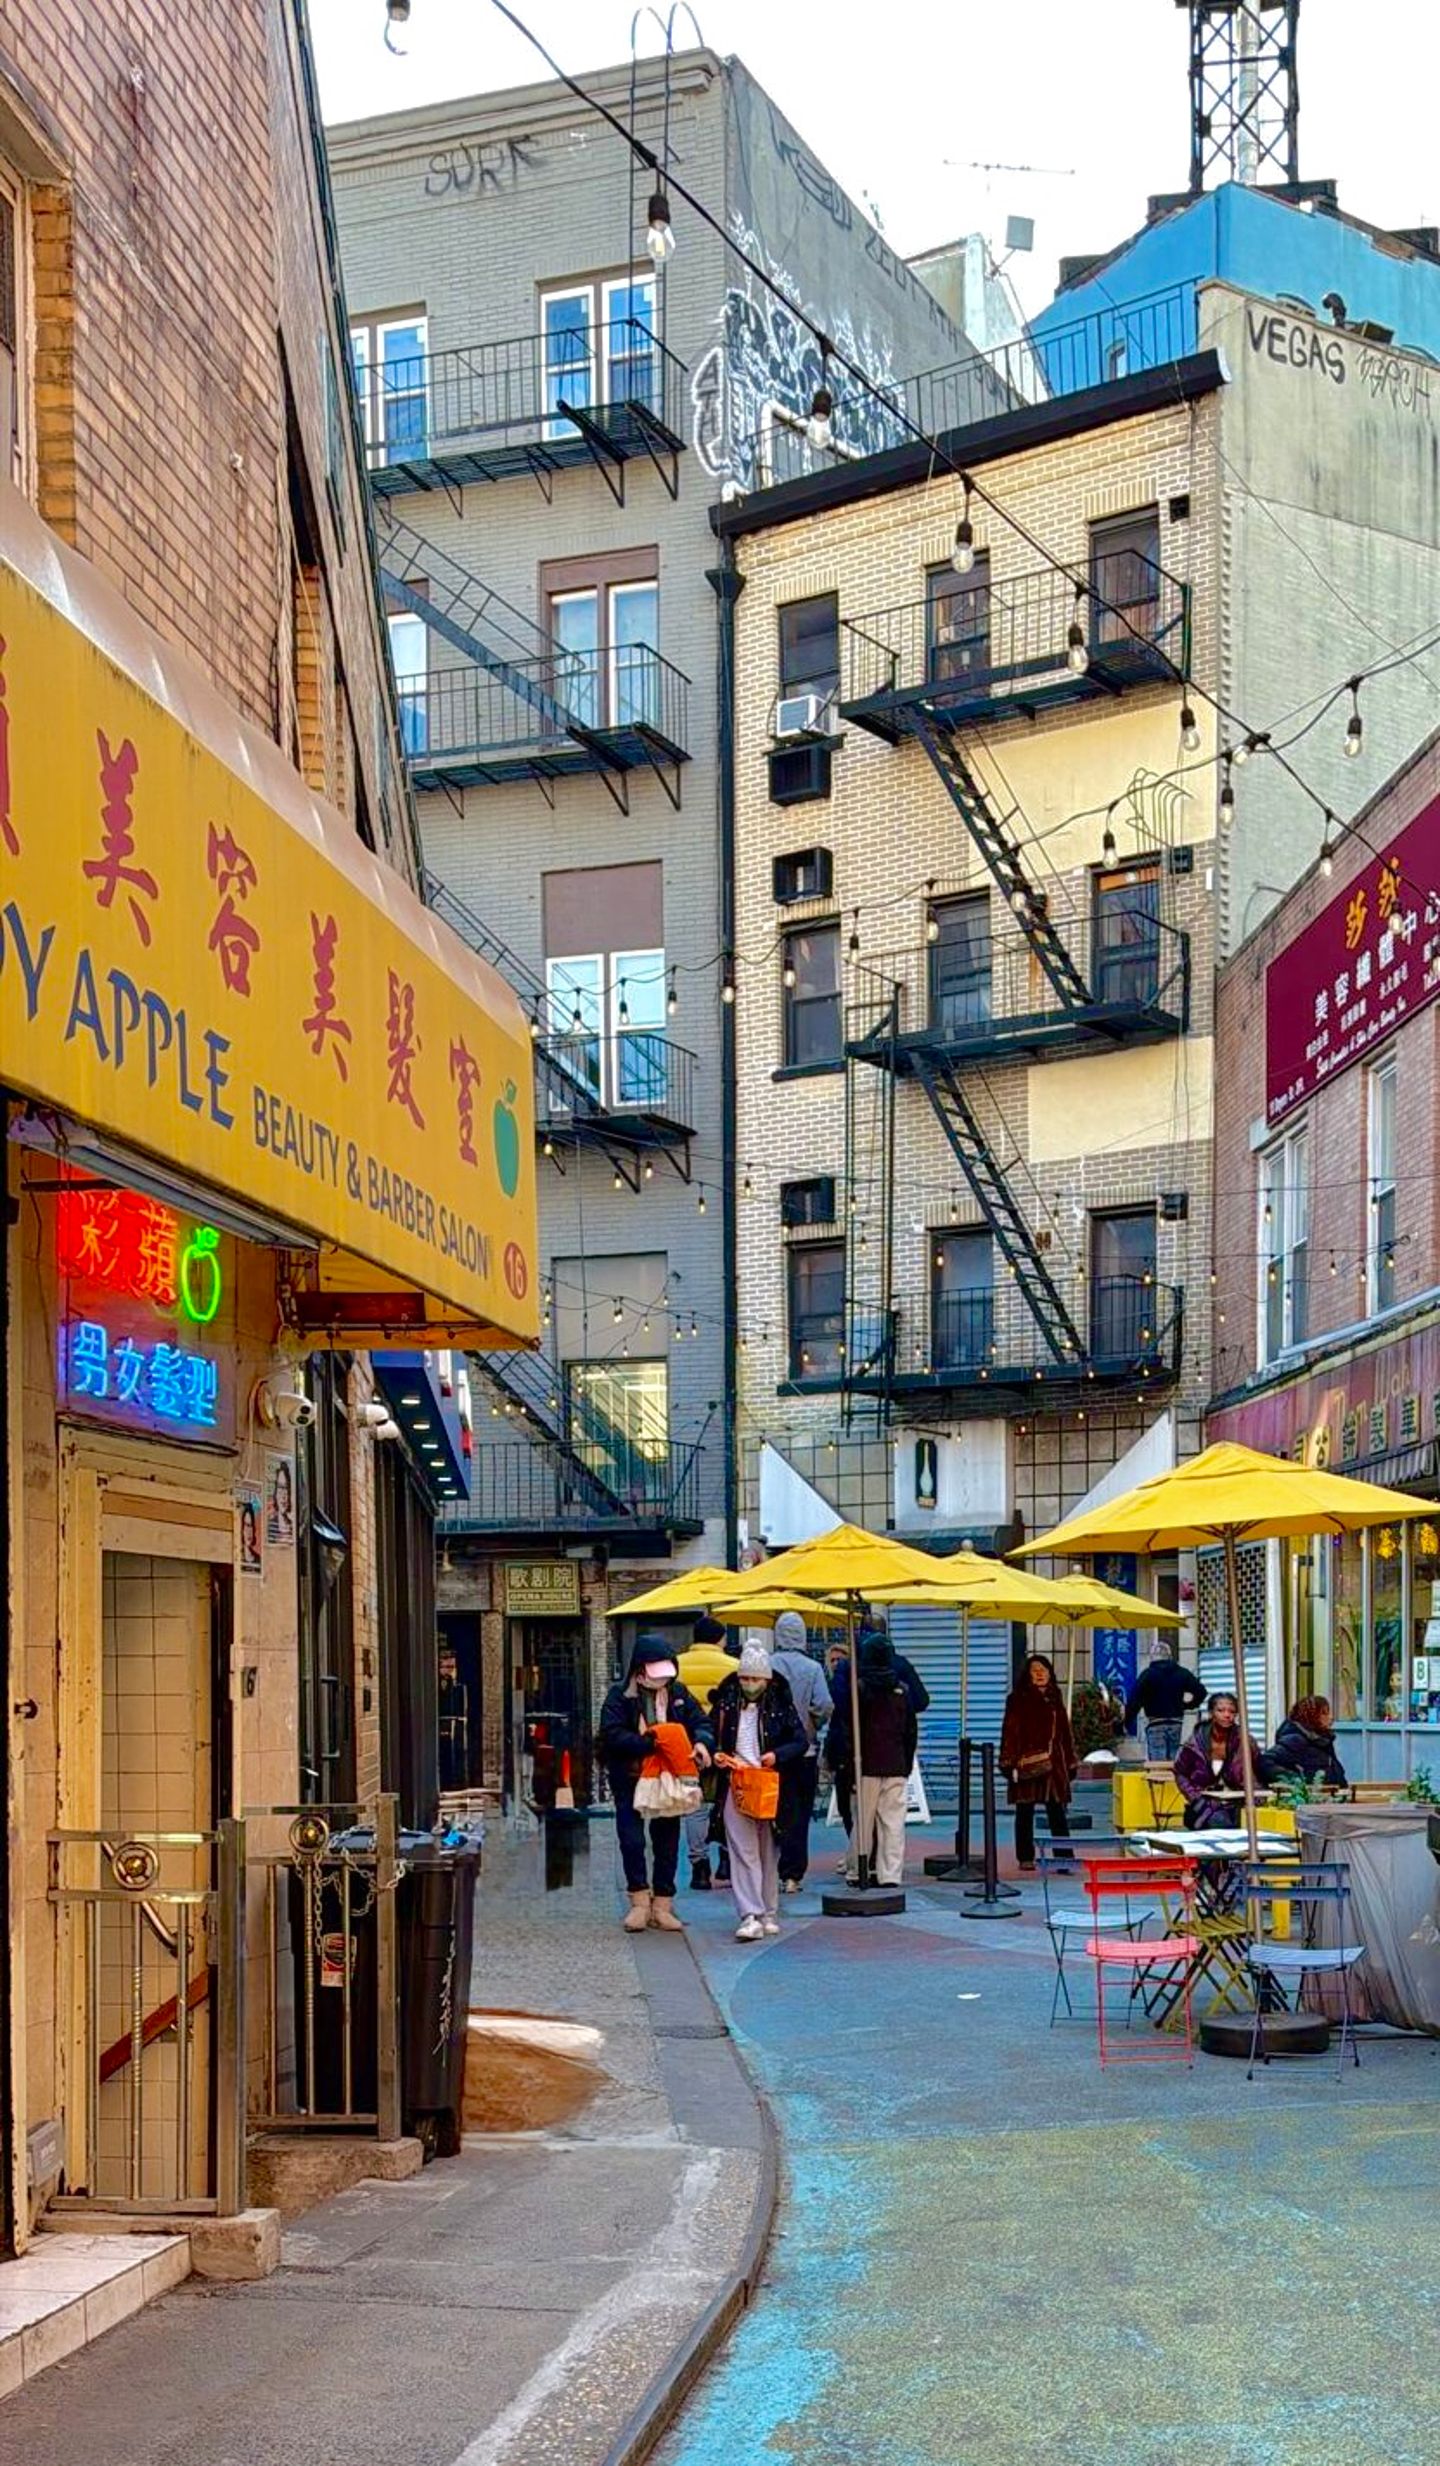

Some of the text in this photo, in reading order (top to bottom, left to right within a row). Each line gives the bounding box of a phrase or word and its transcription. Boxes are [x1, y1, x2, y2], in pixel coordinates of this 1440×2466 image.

[1246, 309, 1346, 385] VEGAS
[0, 633, 483, 1168] 美容美髮室
[0, 902, 489, 1281] Y APPLE BEAUTY & BARBER SALON
[507, 1248, 526, 1293] 16
[510, 1567, 573, 1588] 歌剧院
